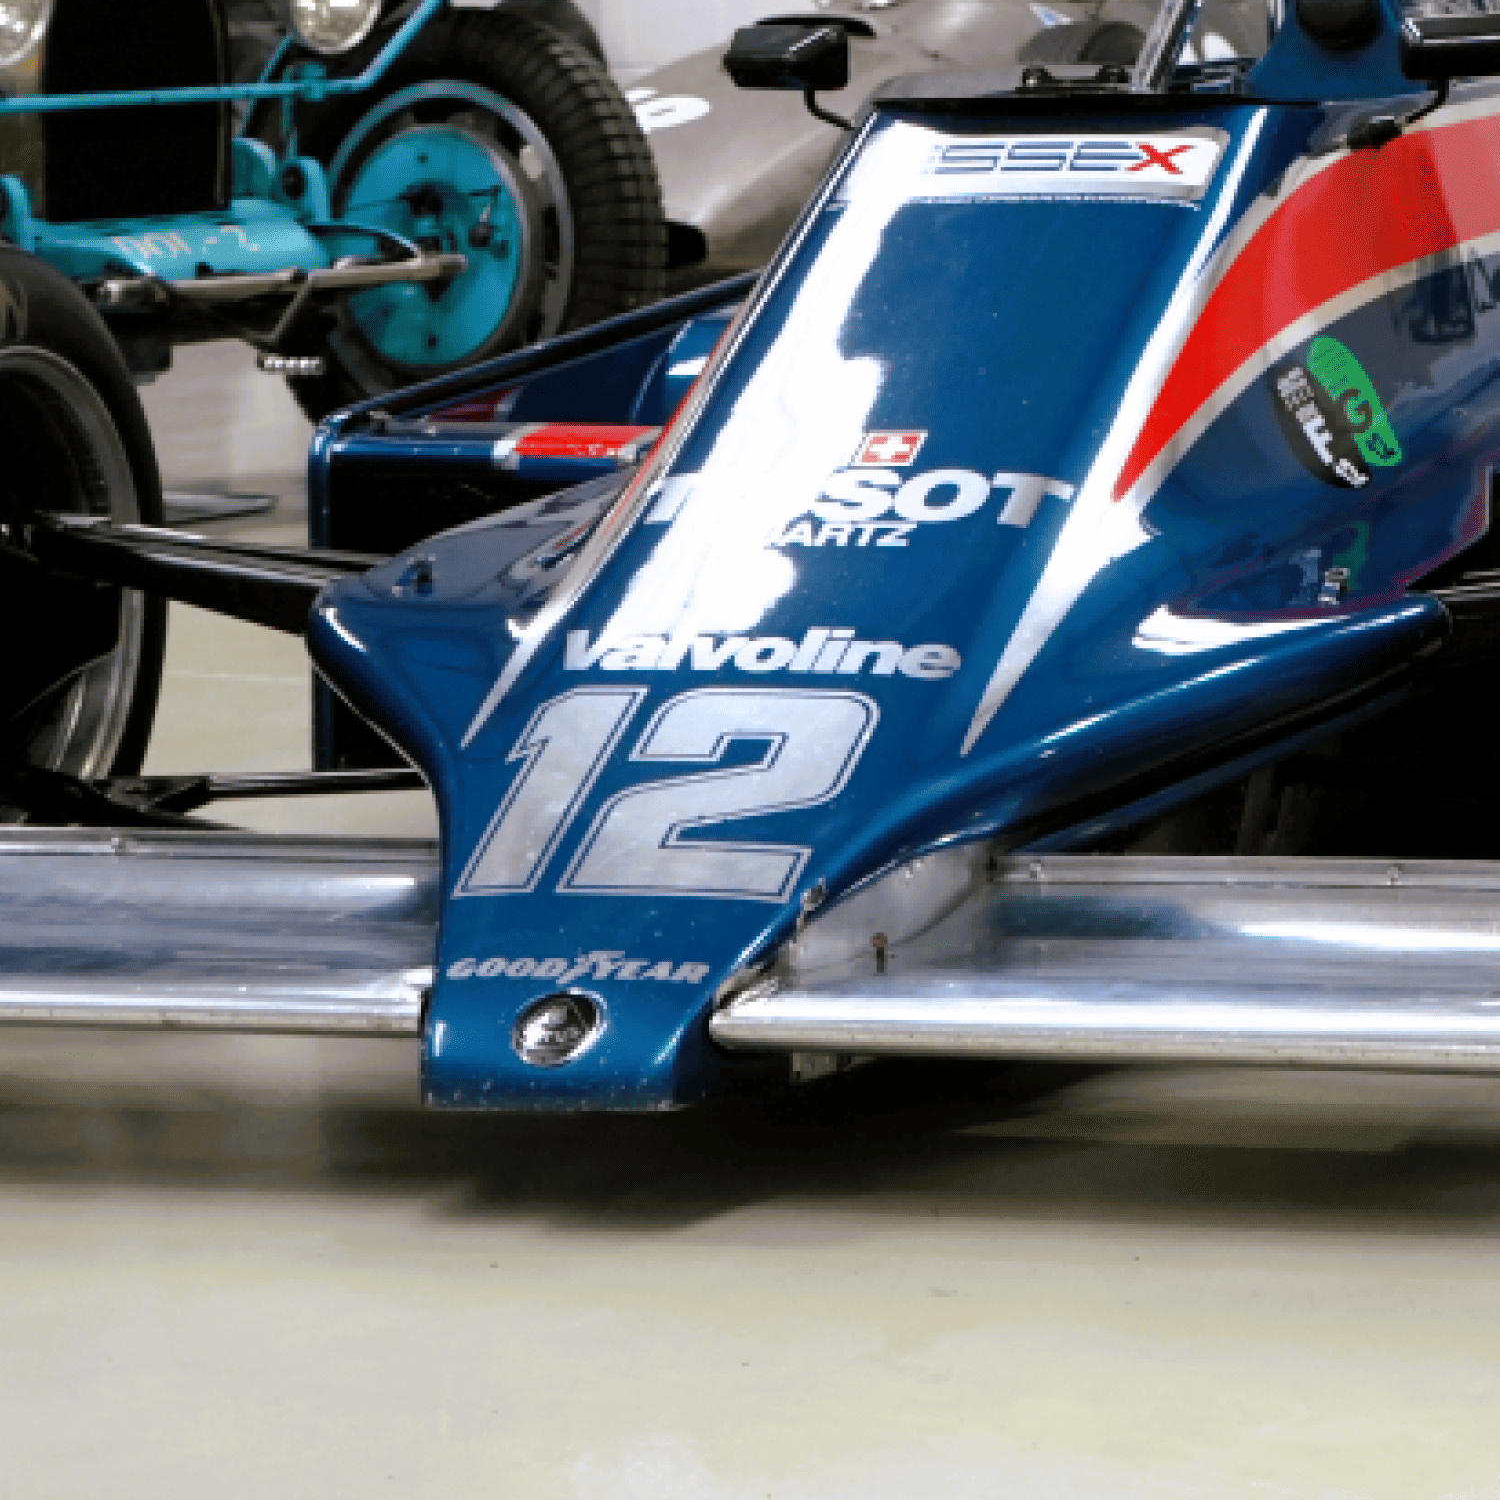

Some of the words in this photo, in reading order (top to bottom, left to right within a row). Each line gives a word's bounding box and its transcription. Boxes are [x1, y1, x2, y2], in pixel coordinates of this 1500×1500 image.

[922, 139, 1194, 175] SSEX
[448, 684, 882, 904] 12
[446, 949, 711, 985] GOODYEAR
